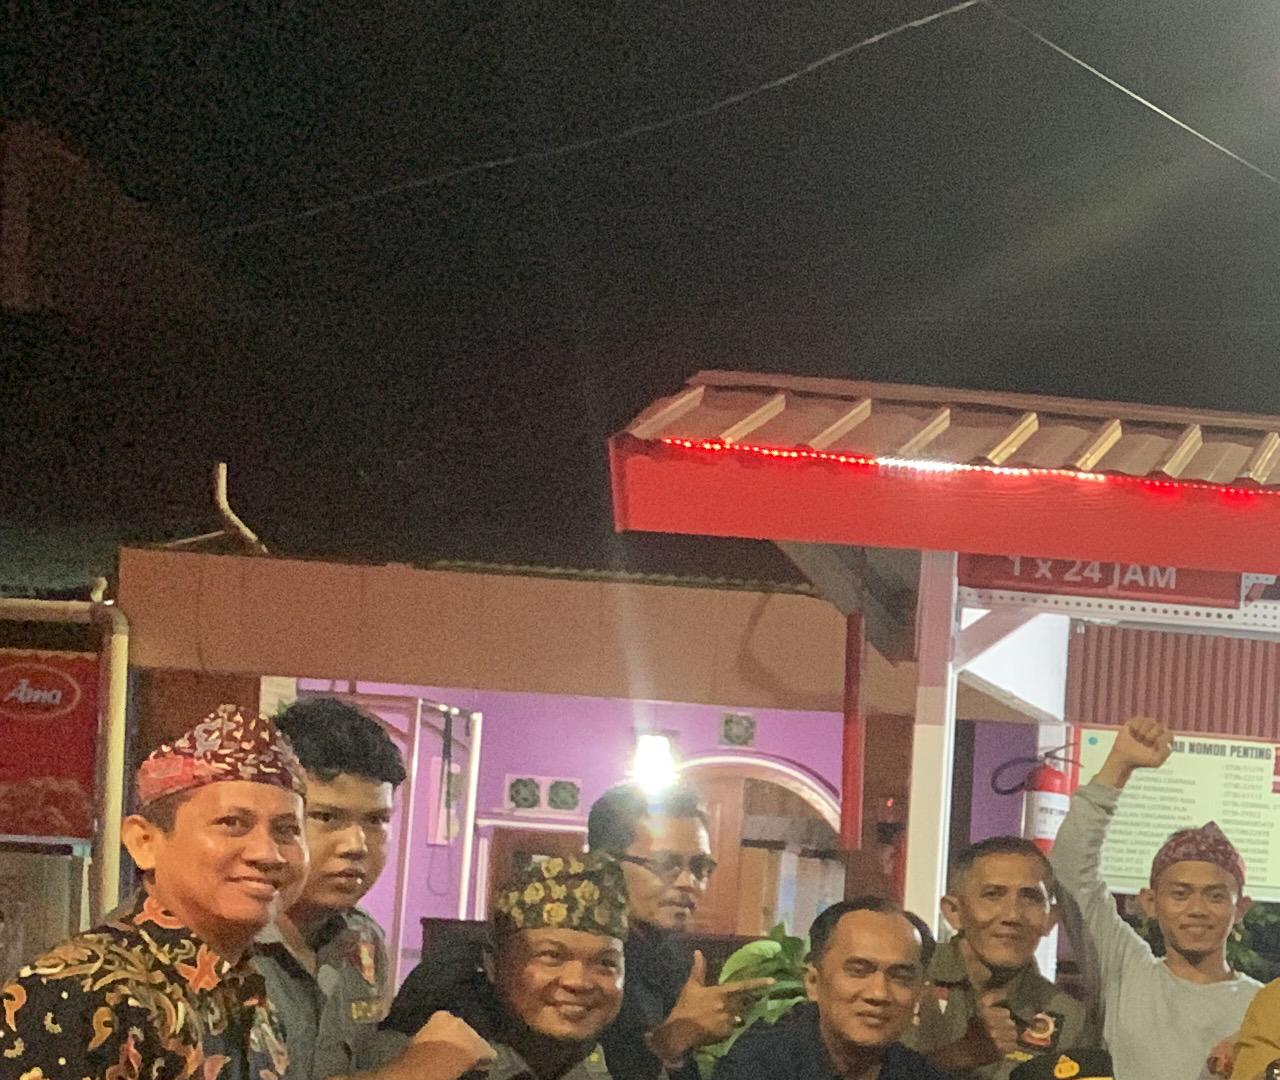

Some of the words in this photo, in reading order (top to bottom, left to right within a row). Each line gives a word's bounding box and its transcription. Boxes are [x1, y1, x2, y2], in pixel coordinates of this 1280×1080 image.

[1064, 560, 1102, 583] 24
[1107, 562, 1177, 592] JAM
[1188, 743, 1227, 757] NOMOR
[1230, 745, 1272, 760] PENTING
